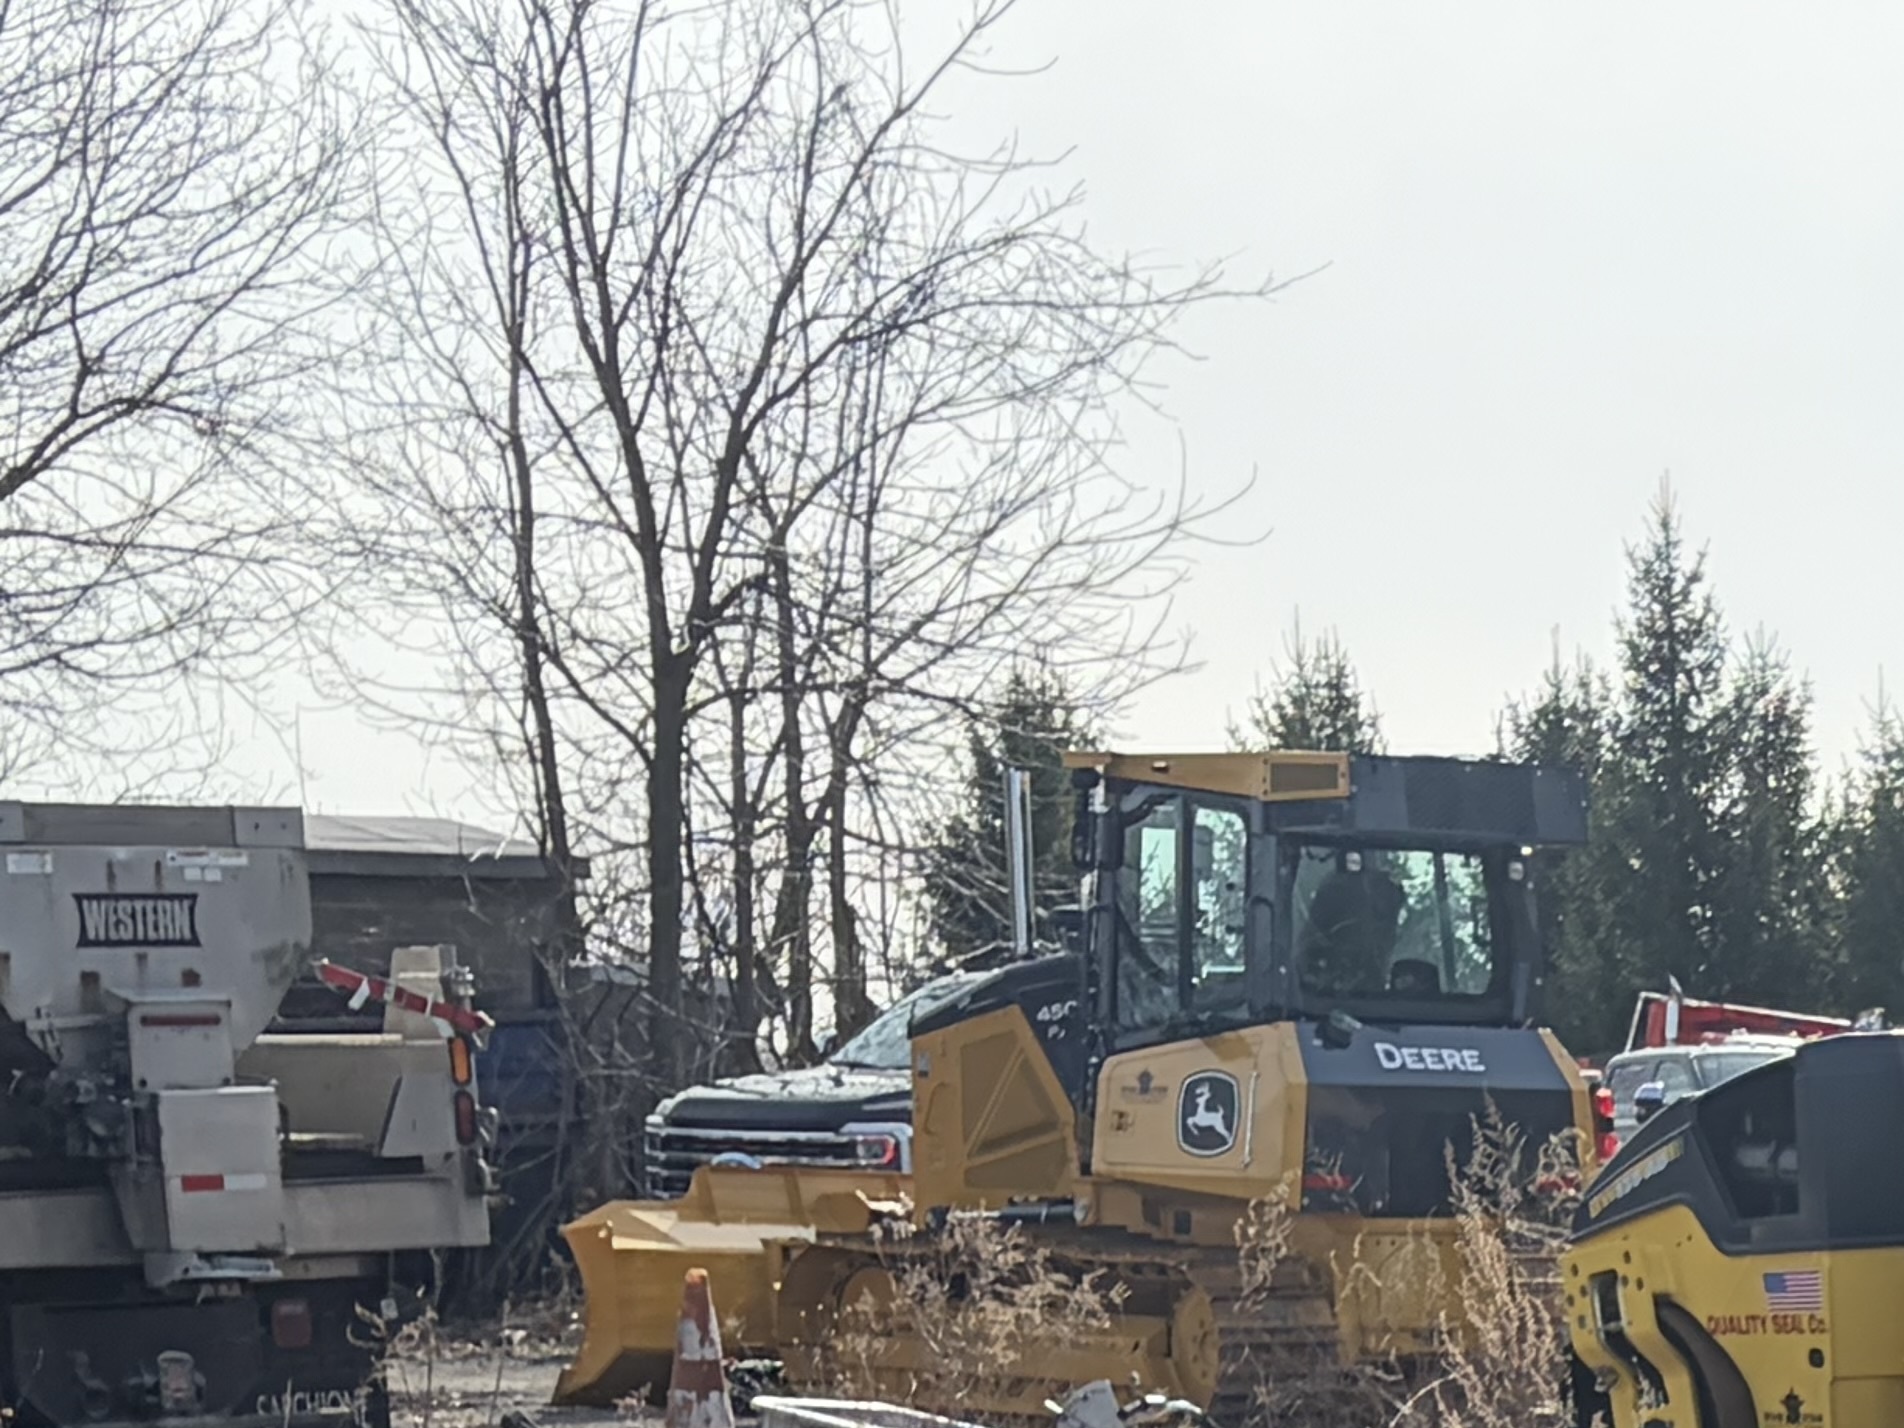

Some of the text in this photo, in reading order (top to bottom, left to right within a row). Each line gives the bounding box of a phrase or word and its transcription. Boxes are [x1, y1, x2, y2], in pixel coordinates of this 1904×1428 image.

[82, 899, 192, 941] WESTERN
[1374, 1042, 1486, 1072] DEERE
[1707, 1313, 1767, 1335] QUALITY
[1771, 1313, 1806, 1335] SEAL
